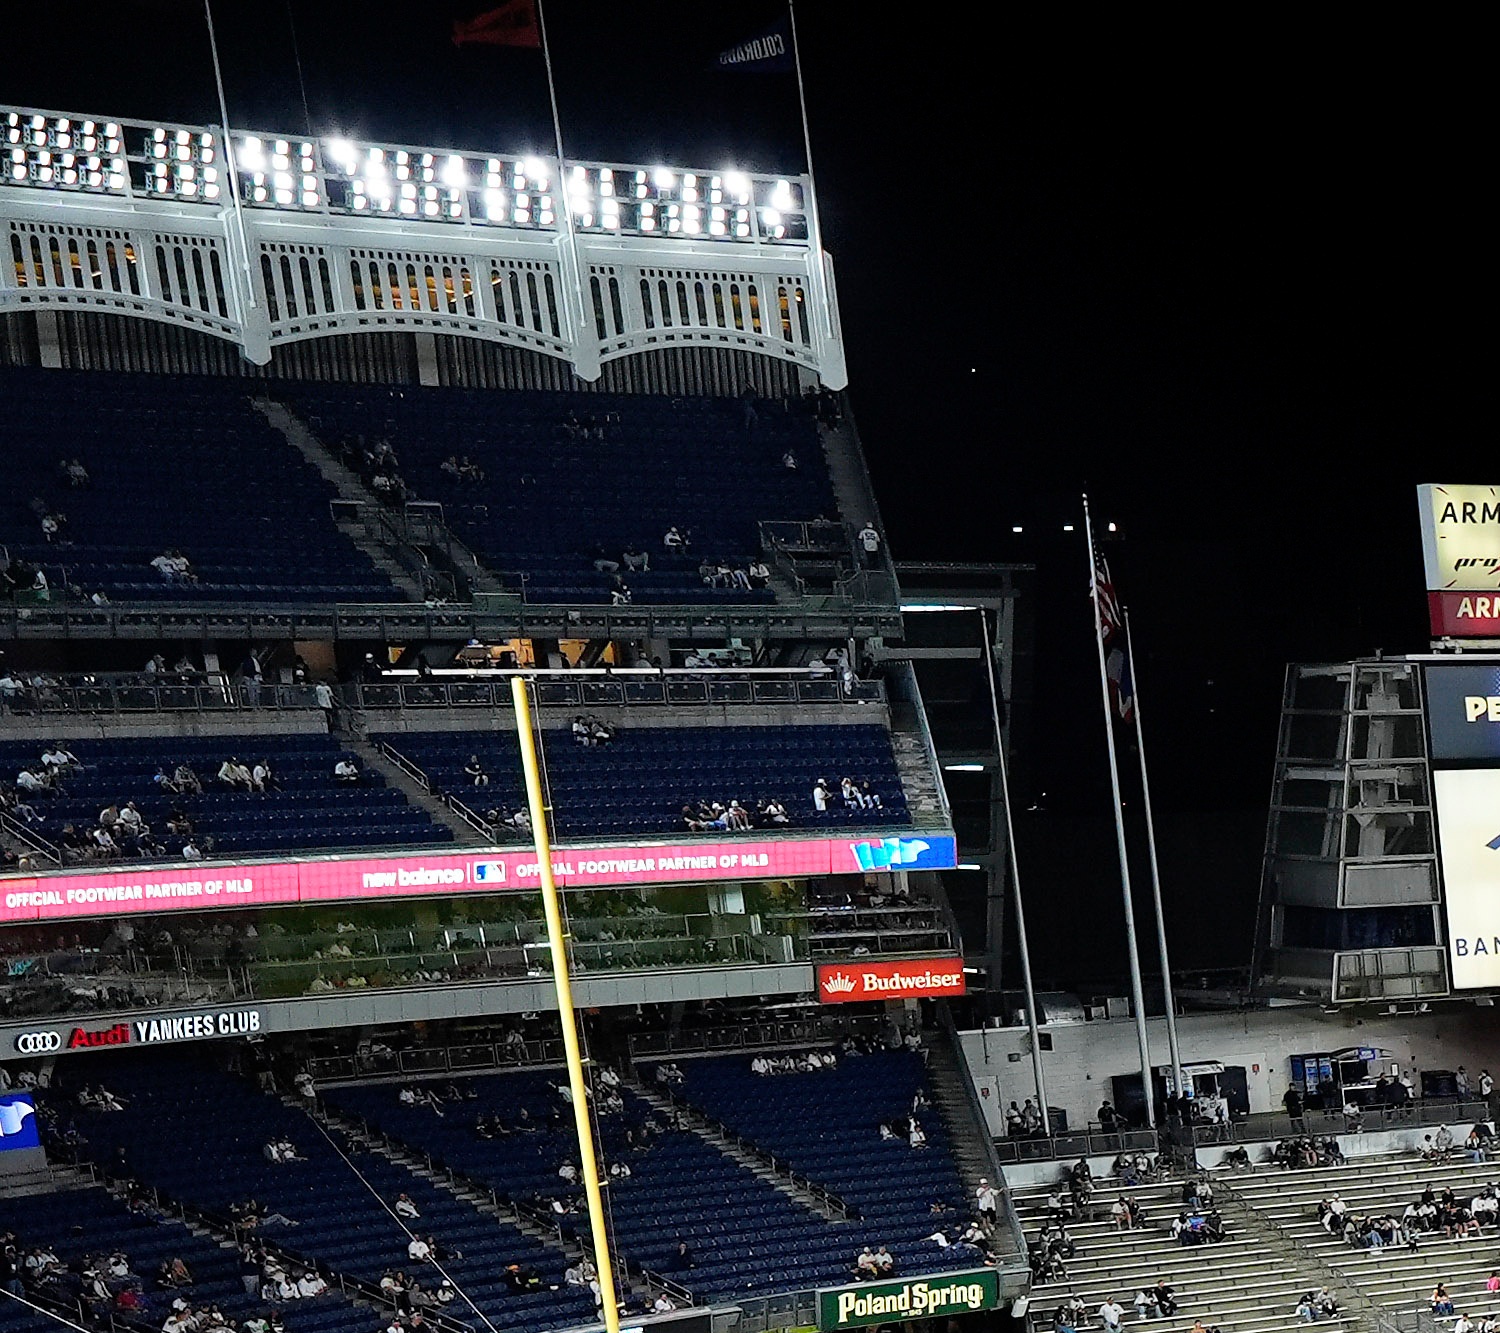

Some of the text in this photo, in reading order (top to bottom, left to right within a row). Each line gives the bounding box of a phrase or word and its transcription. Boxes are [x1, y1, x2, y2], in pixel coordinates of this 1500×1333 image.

[577, 853, 768, 874] FOOTWEAR PARTNER MLB
[67, 879, 252, 905] FOOTWEAR PARTNER MLB
[863, 972, 961, 991] Budweiser
[69, 1012, 260, 1049] Audi YANKEES CLUB
[838, 1282, 981, 1323] Poland Spring
